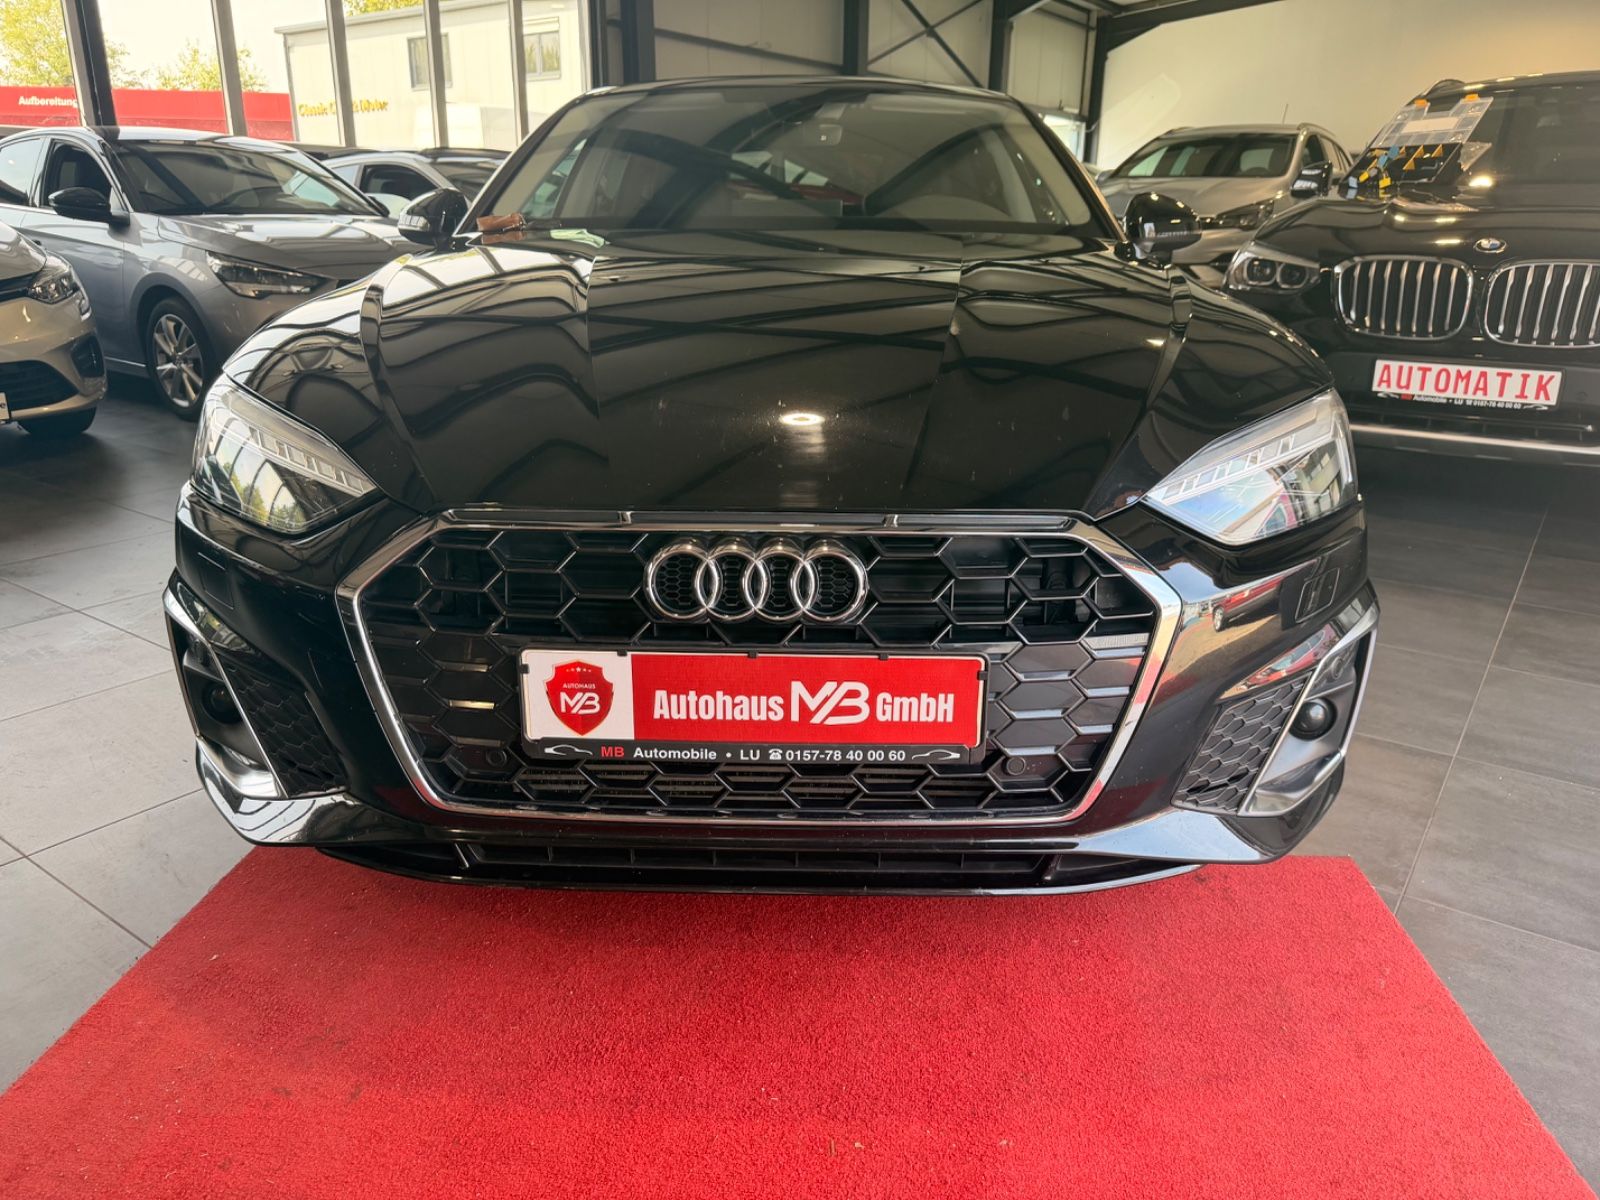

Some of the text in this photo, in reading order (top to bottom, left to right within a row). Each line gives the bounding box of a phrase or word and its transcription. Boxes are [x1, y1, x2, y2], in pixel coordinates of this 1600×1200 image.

[18, 96, 78, 109] Aufbereitung
[1376, 364, 1556, 401] AUTOMATIK
[560, 691, 601, 714] MB
[653, 680, 955, 726] Autohaus MB GmbH
[601, 746, 906, 761] MB Automobile LU 0157-78 40 00 60
